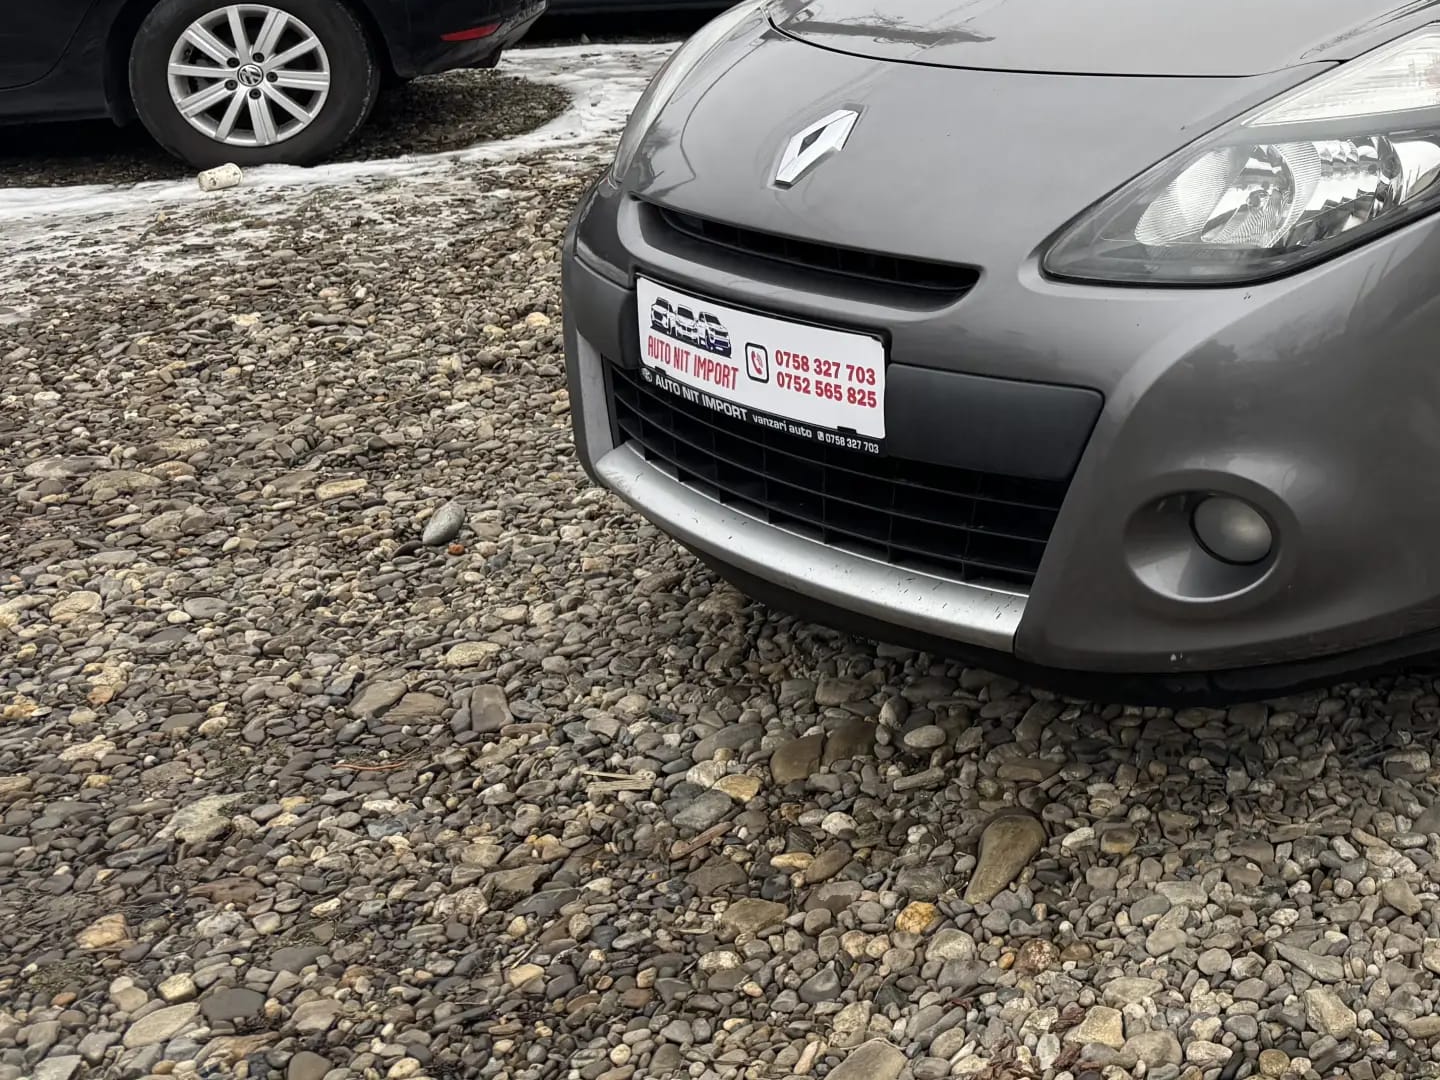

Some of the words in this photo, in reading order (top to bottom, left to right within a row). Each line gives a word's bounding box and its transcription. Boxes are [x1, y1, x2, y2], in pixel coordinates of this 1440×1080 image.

[647, 335, 671, 365] AUTO
[673, 346, 690, 374] NIT
[693, 354, 739, 390] IMPORT
[775, 349, 810, 373] 0758
[813, 358, 841, 379] 327
[846, 364, 876, 386] 703
[776, 371, 811, 395] 0752
[815, 380, 843, 402] 565
[847, 387, 877, 408] 825
[655, 374, 681, 396] AUTO
[682, 386, 700, 404] NIT
[701, 394, 748, 421] IMPORT
[752, 414, 787, 432] vanzari
[788, 424, 813, 438] auto
[825, 433, 846, 447] 0758
[846, 438, 862, 450] 327
[863, 441, 879, 454] 703
